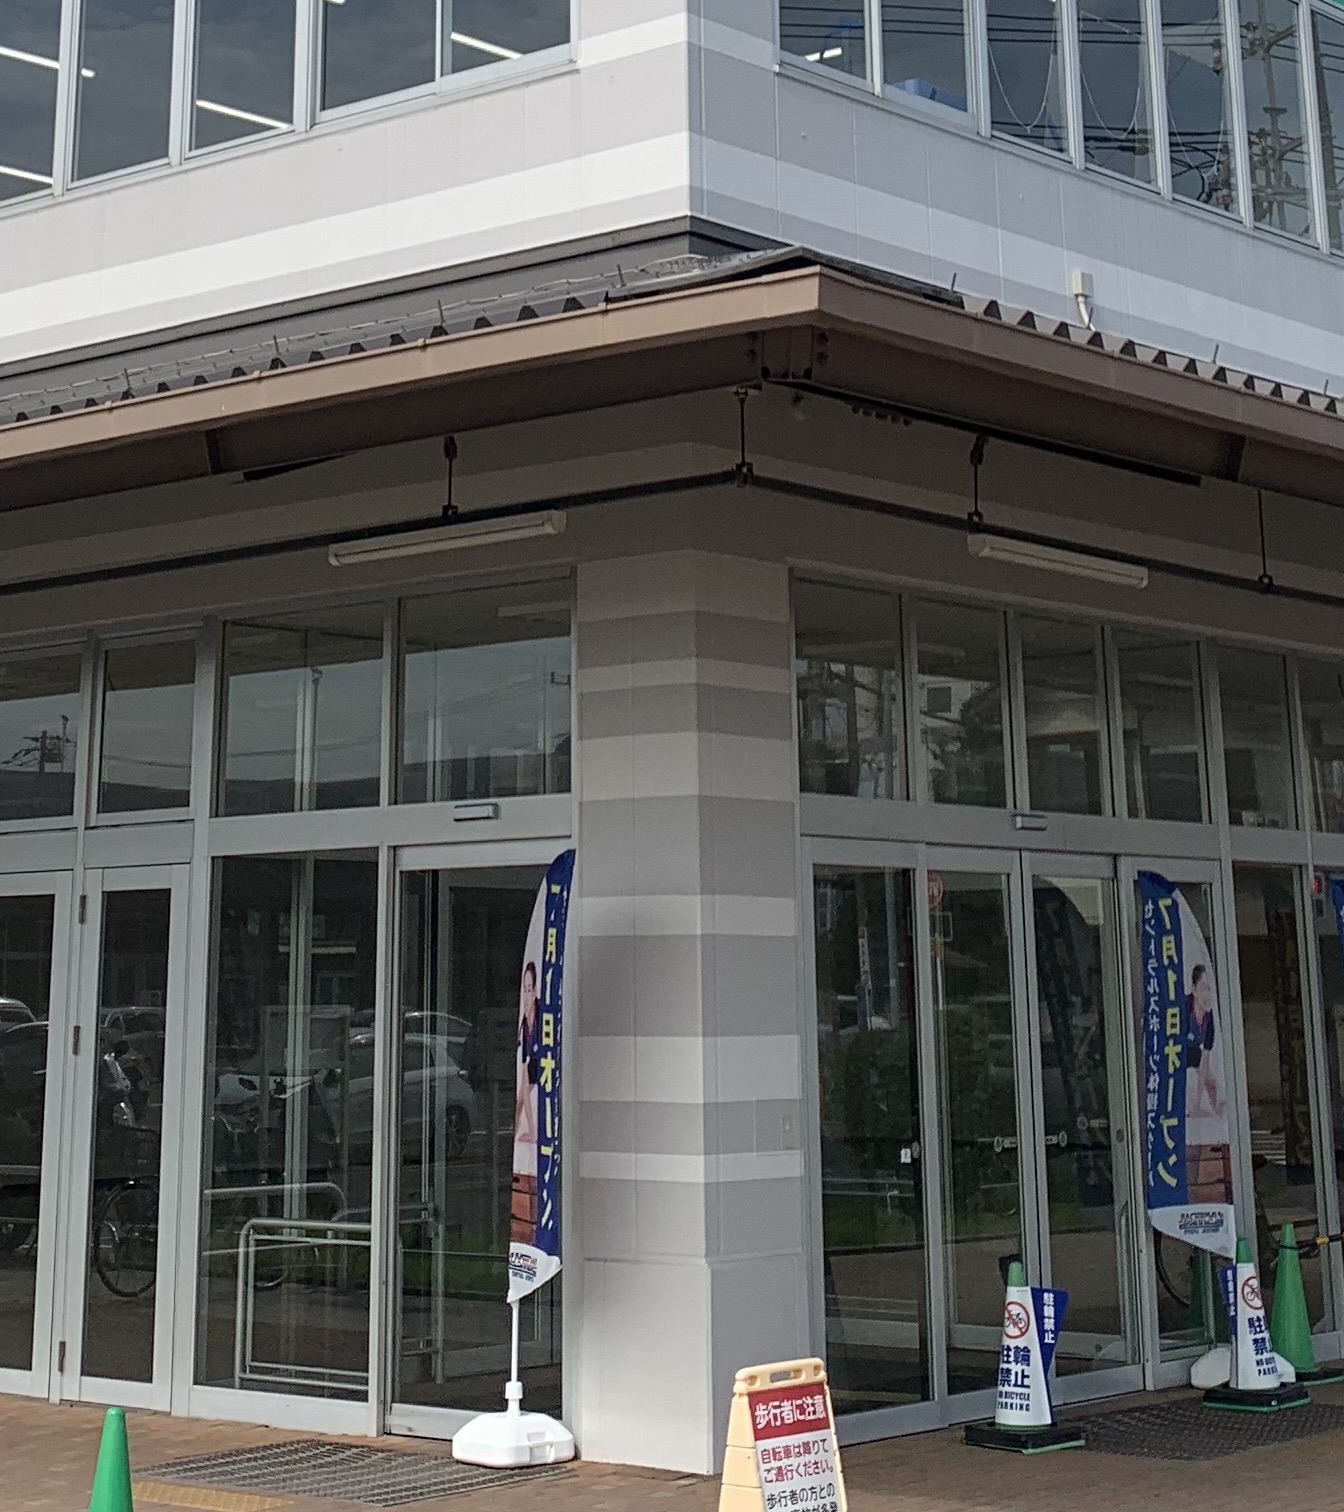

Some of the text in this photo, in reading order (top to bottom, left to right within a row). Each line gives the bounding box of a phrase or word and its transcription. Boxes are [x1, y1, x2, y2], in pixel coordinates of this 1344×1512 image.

[999, 1367, 1031, 1389] 禁止
[754, 1393, 826, 1430] 歩行者に注意
[760, 1438, 829, 1465] 自転車は降りて
[762, 1459, 834, 1483] ご通行ください。
[766, 1482, 835, 1510] 歩行者の方との
